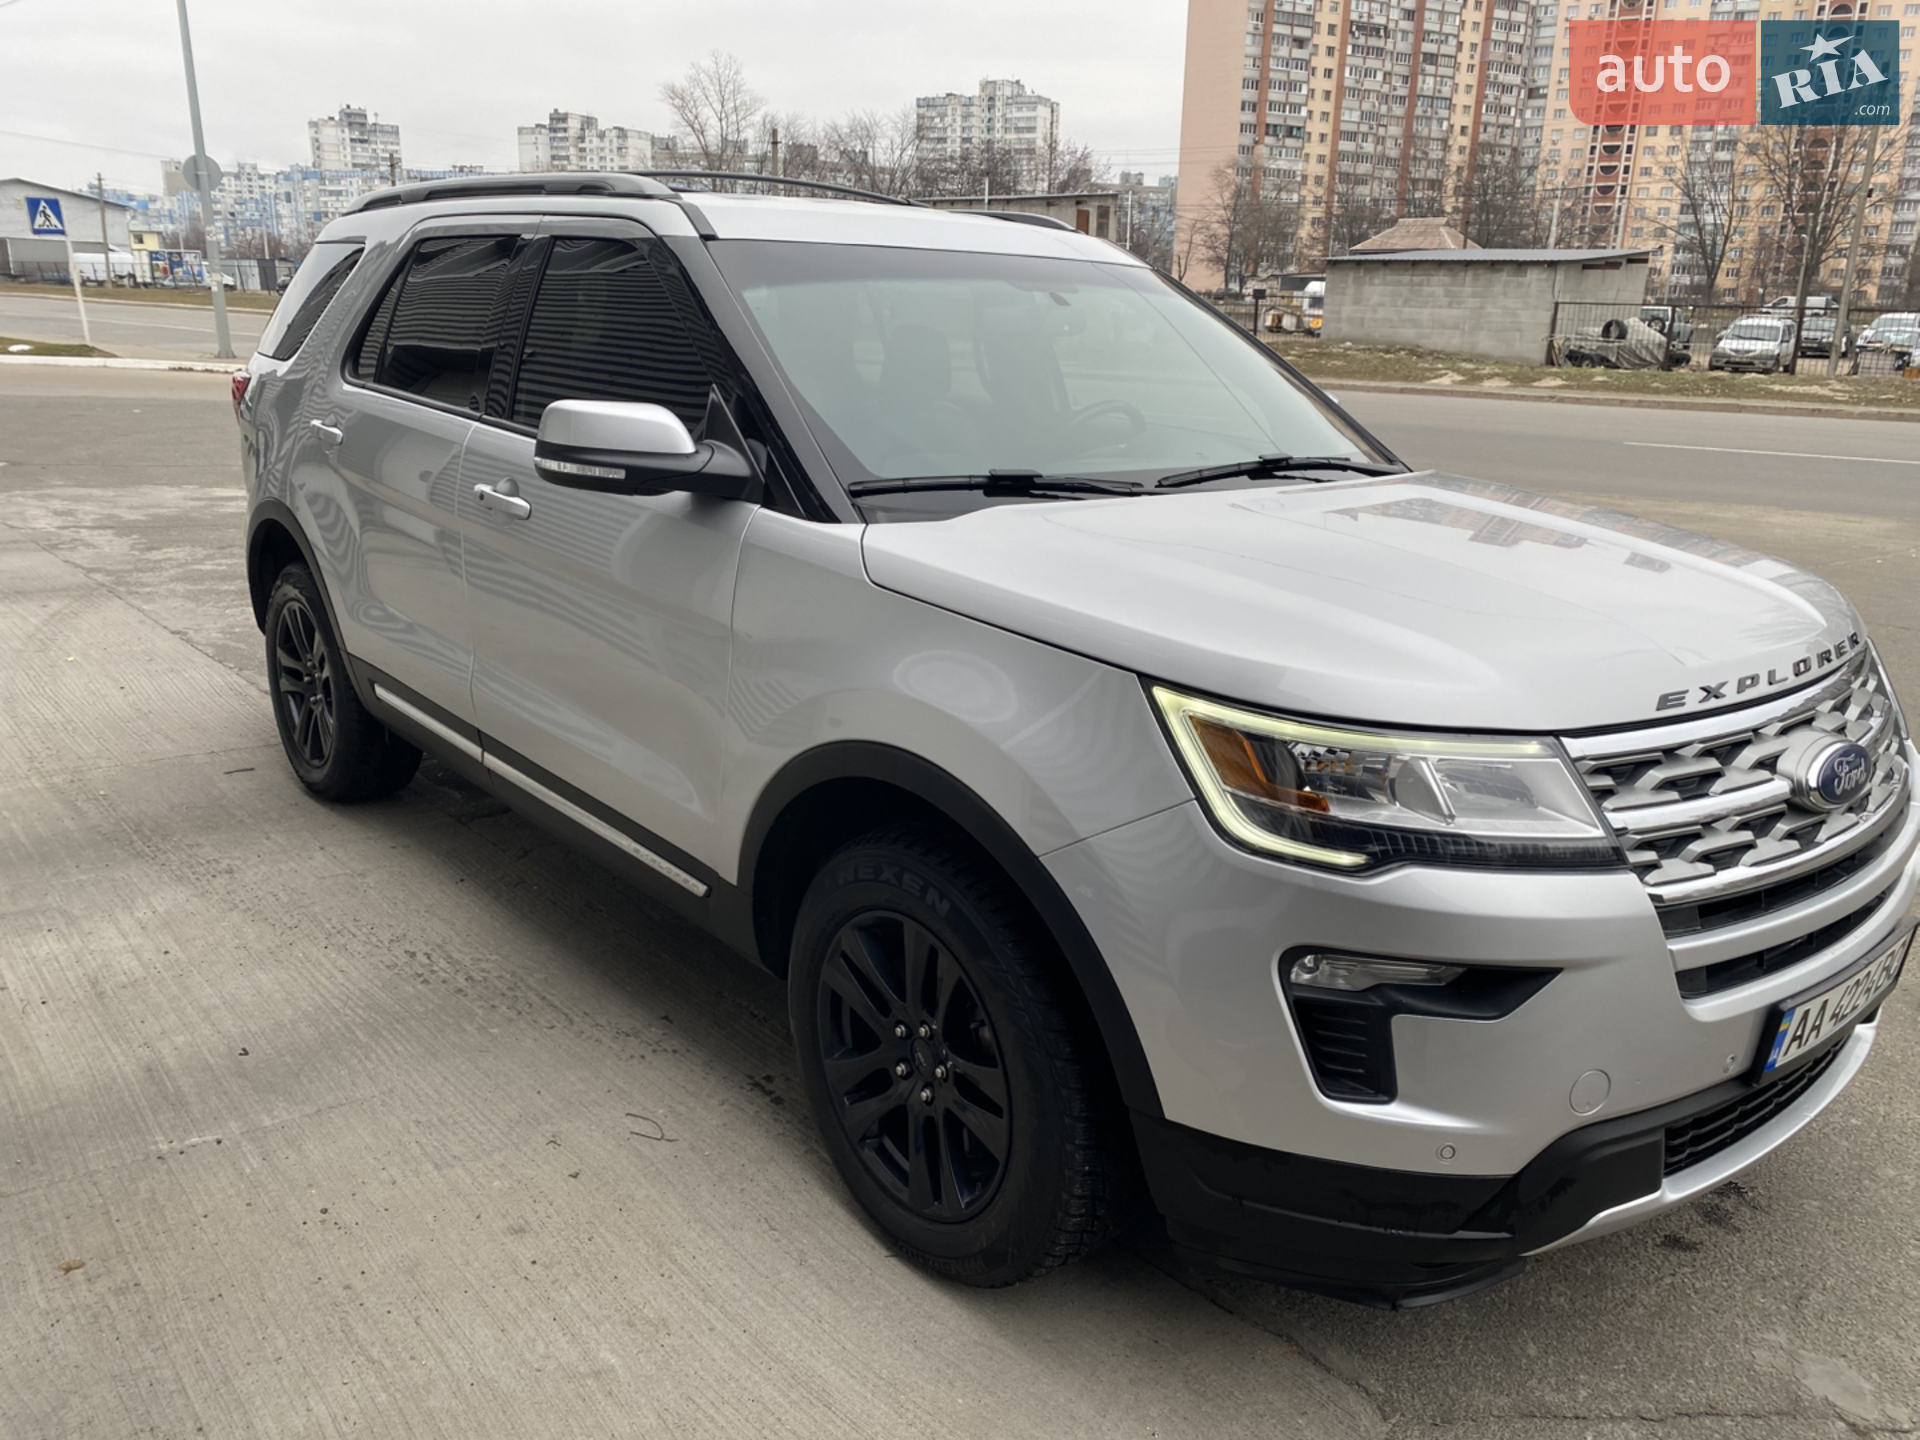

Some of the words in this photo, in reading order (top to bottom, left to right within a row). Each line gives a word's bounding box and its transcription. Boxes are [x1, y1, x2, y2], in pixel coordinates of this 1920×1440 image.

[1655, 631, 1860, 711] EXPLORER
[1833, 753, 1867, 796] Ford
[836, 863, 951, 919] NEXEN
[1783, 998, 1830, 1057] AA
